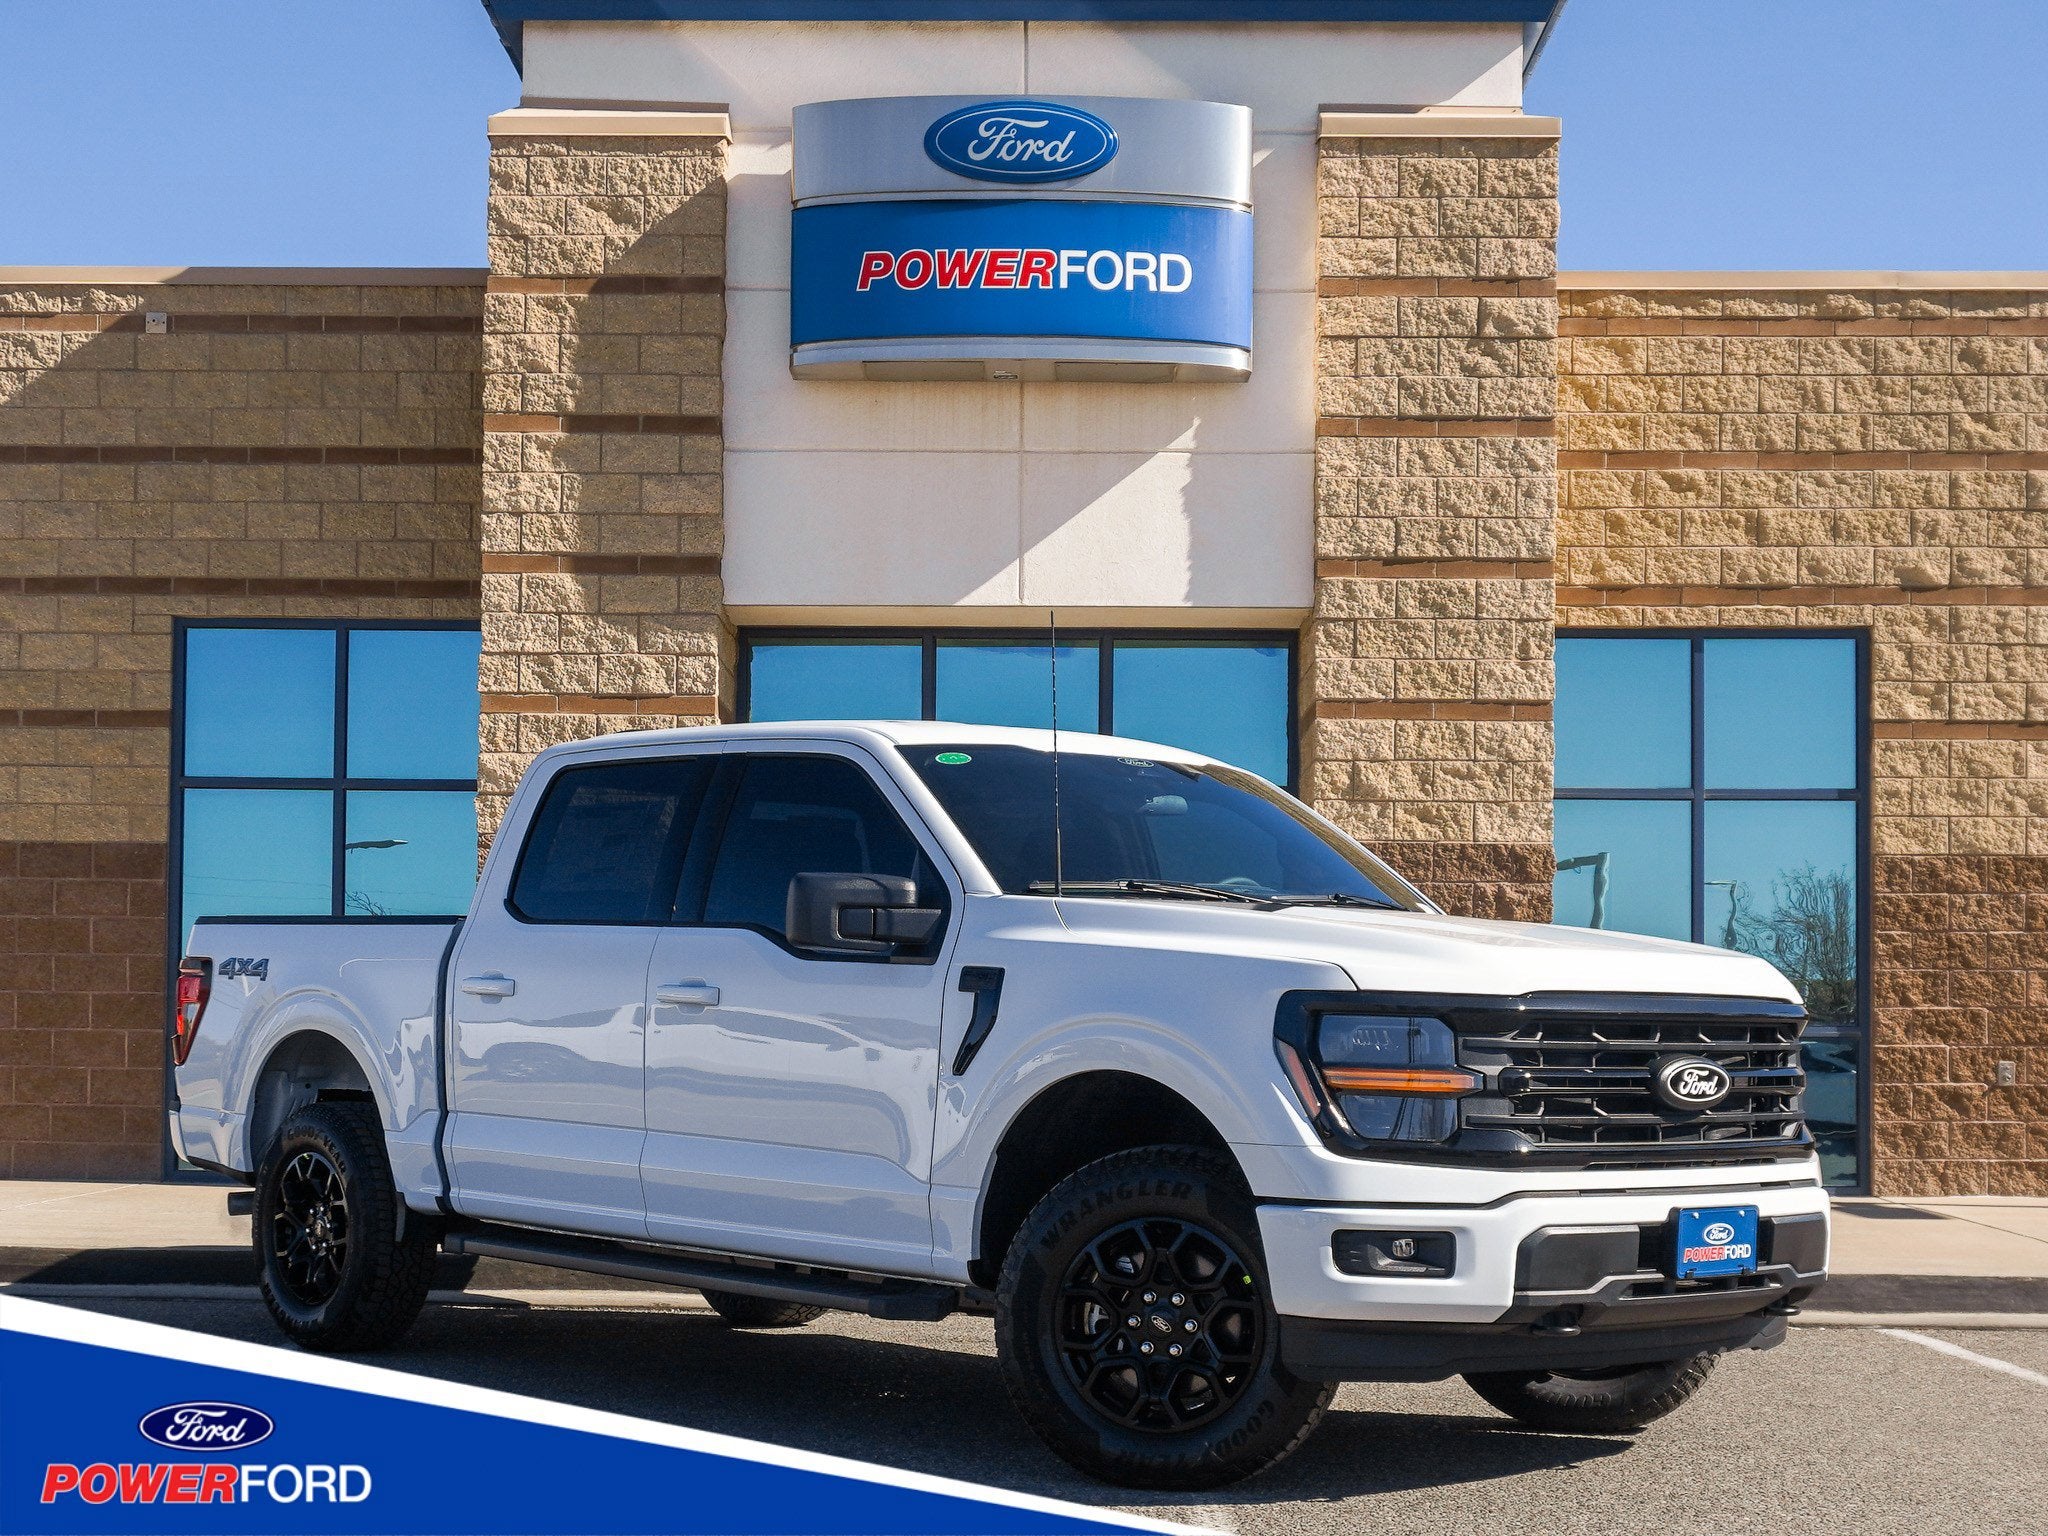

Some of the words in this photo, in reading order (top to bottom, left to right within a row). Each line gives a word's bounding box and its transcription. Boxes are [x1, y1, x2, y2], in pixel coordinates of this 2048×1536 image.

[967, 117, 1076, 163] Ford
[1679, 1068, 1719, 1096] Ford
[1709, 1226, 1729, 1241] Ford
